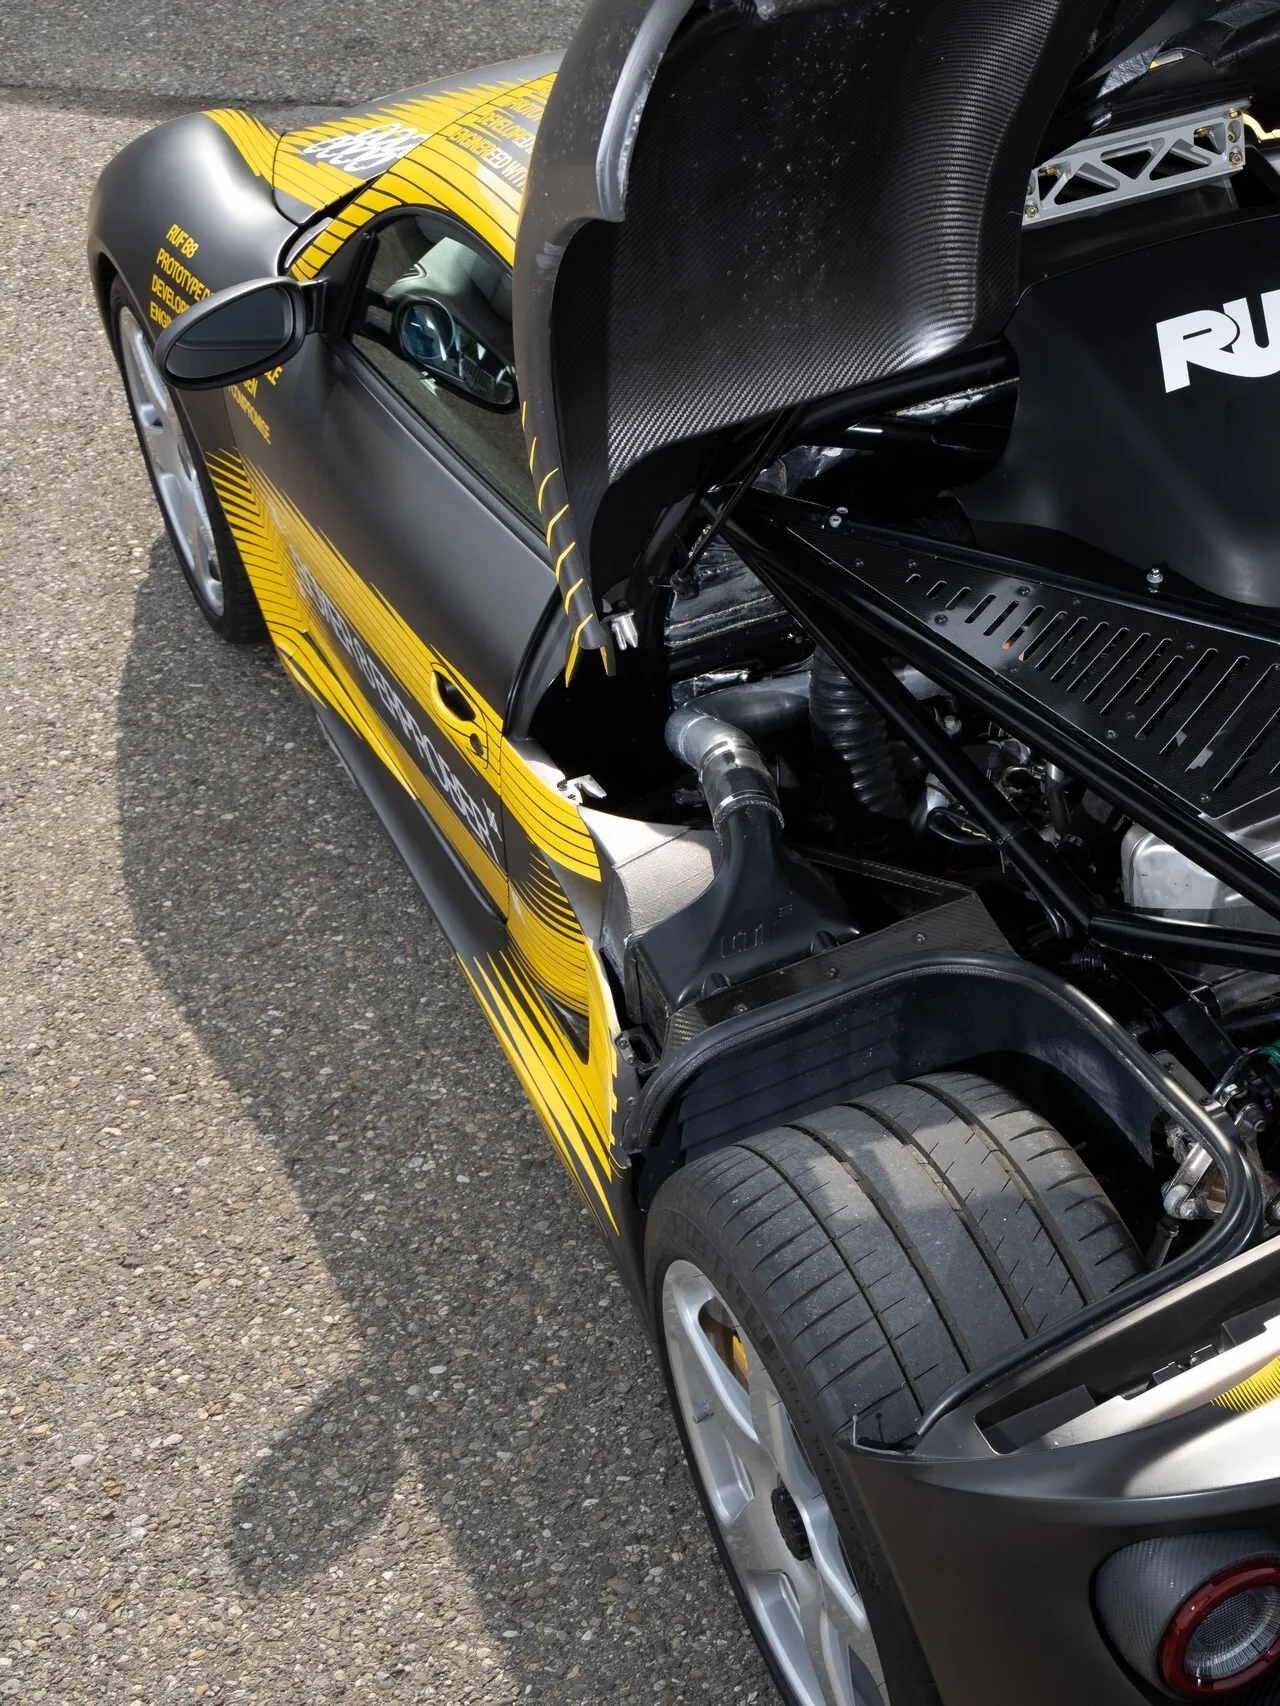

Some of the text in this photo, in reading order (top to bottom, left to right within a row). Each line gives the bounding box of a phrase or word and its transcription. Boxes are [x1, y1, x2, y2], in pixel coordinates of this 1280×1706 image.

[165, 224, 199, 259] RUF B8
[151, 273, 190, 314] DEVELOP
[156, 247, 205, 302] PROTOTYPE
